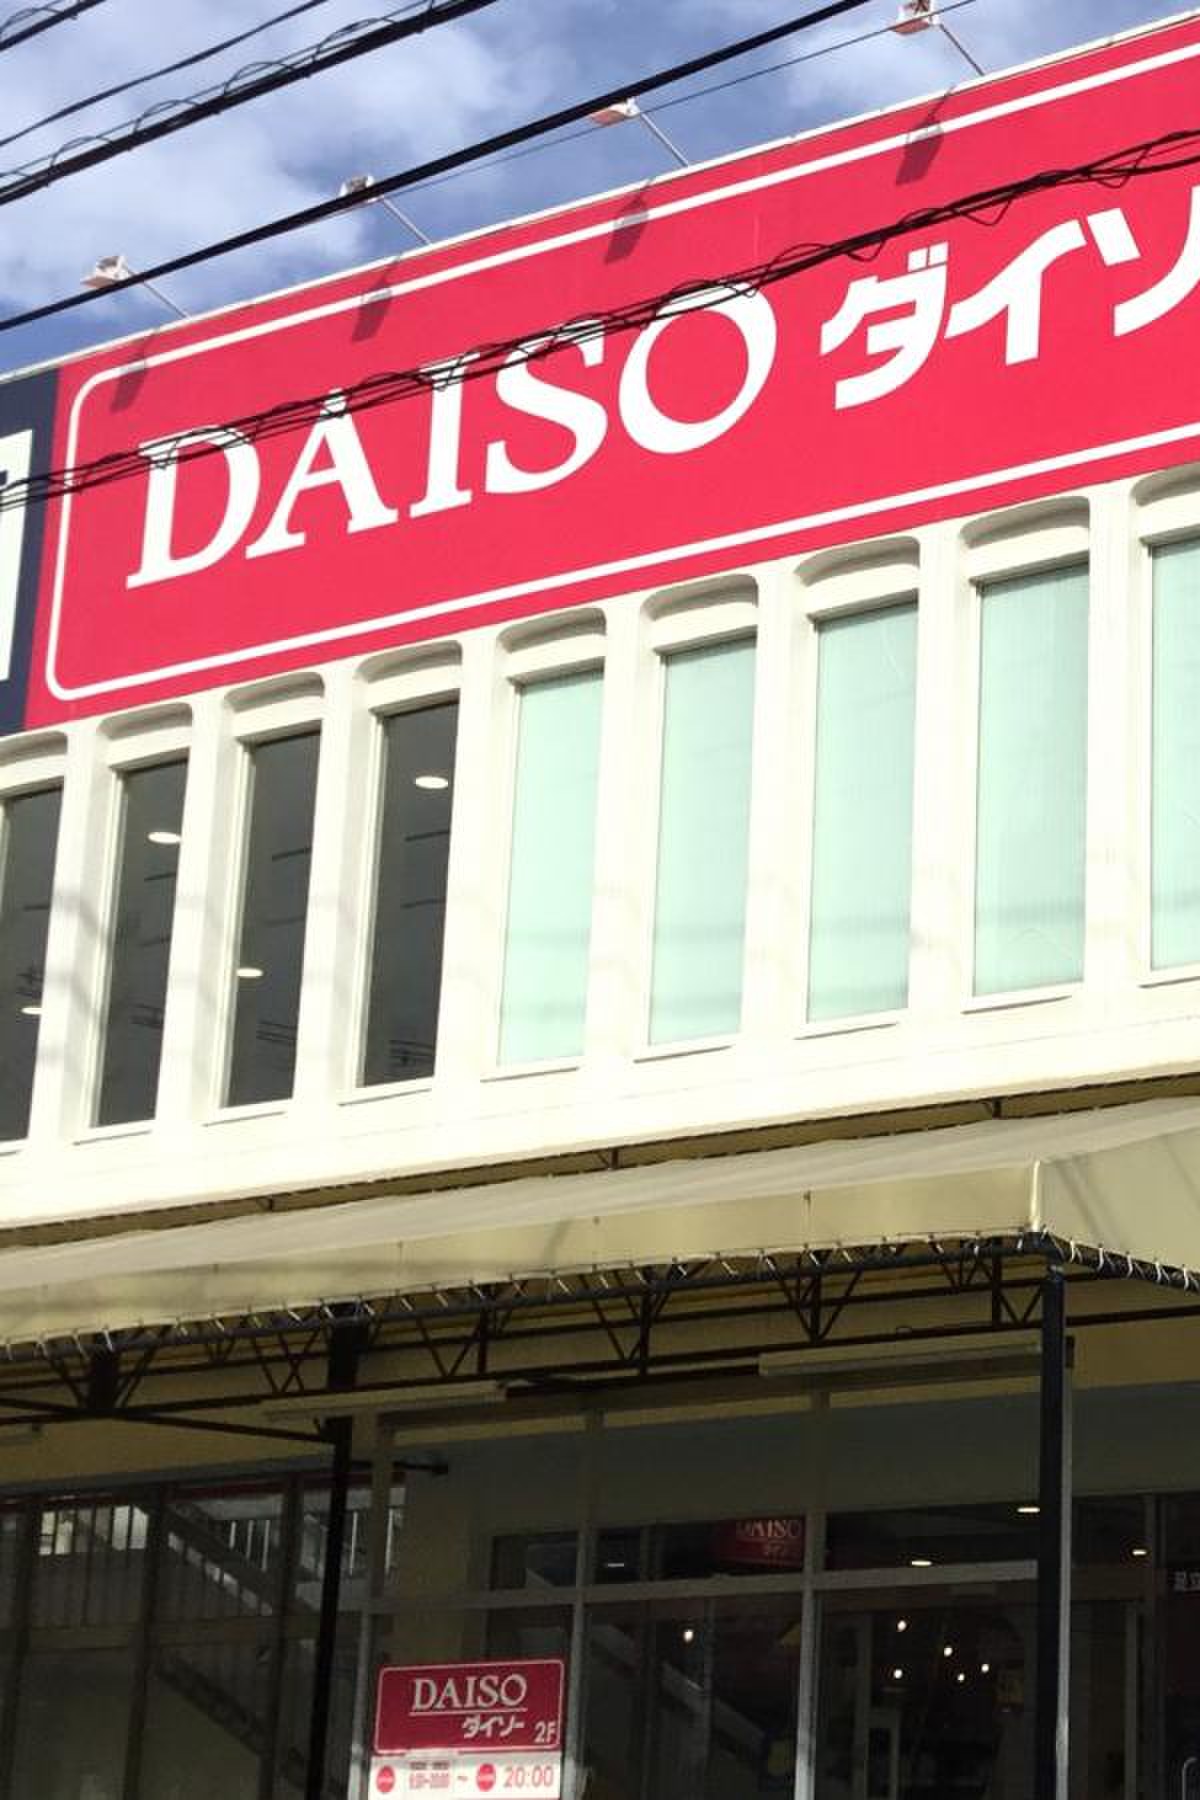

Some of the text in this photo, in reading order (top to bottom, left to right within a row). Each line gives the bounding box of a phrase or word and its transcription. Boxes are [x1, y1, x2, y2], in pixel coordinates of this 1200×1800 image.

[126, 283, 778, 590] DAISO
[412, 1674, 527, 1710] DAISO
[462, 1714, 556, 1744] ダイソー 2F
[504, 1766, 554, 1788] 20:00
